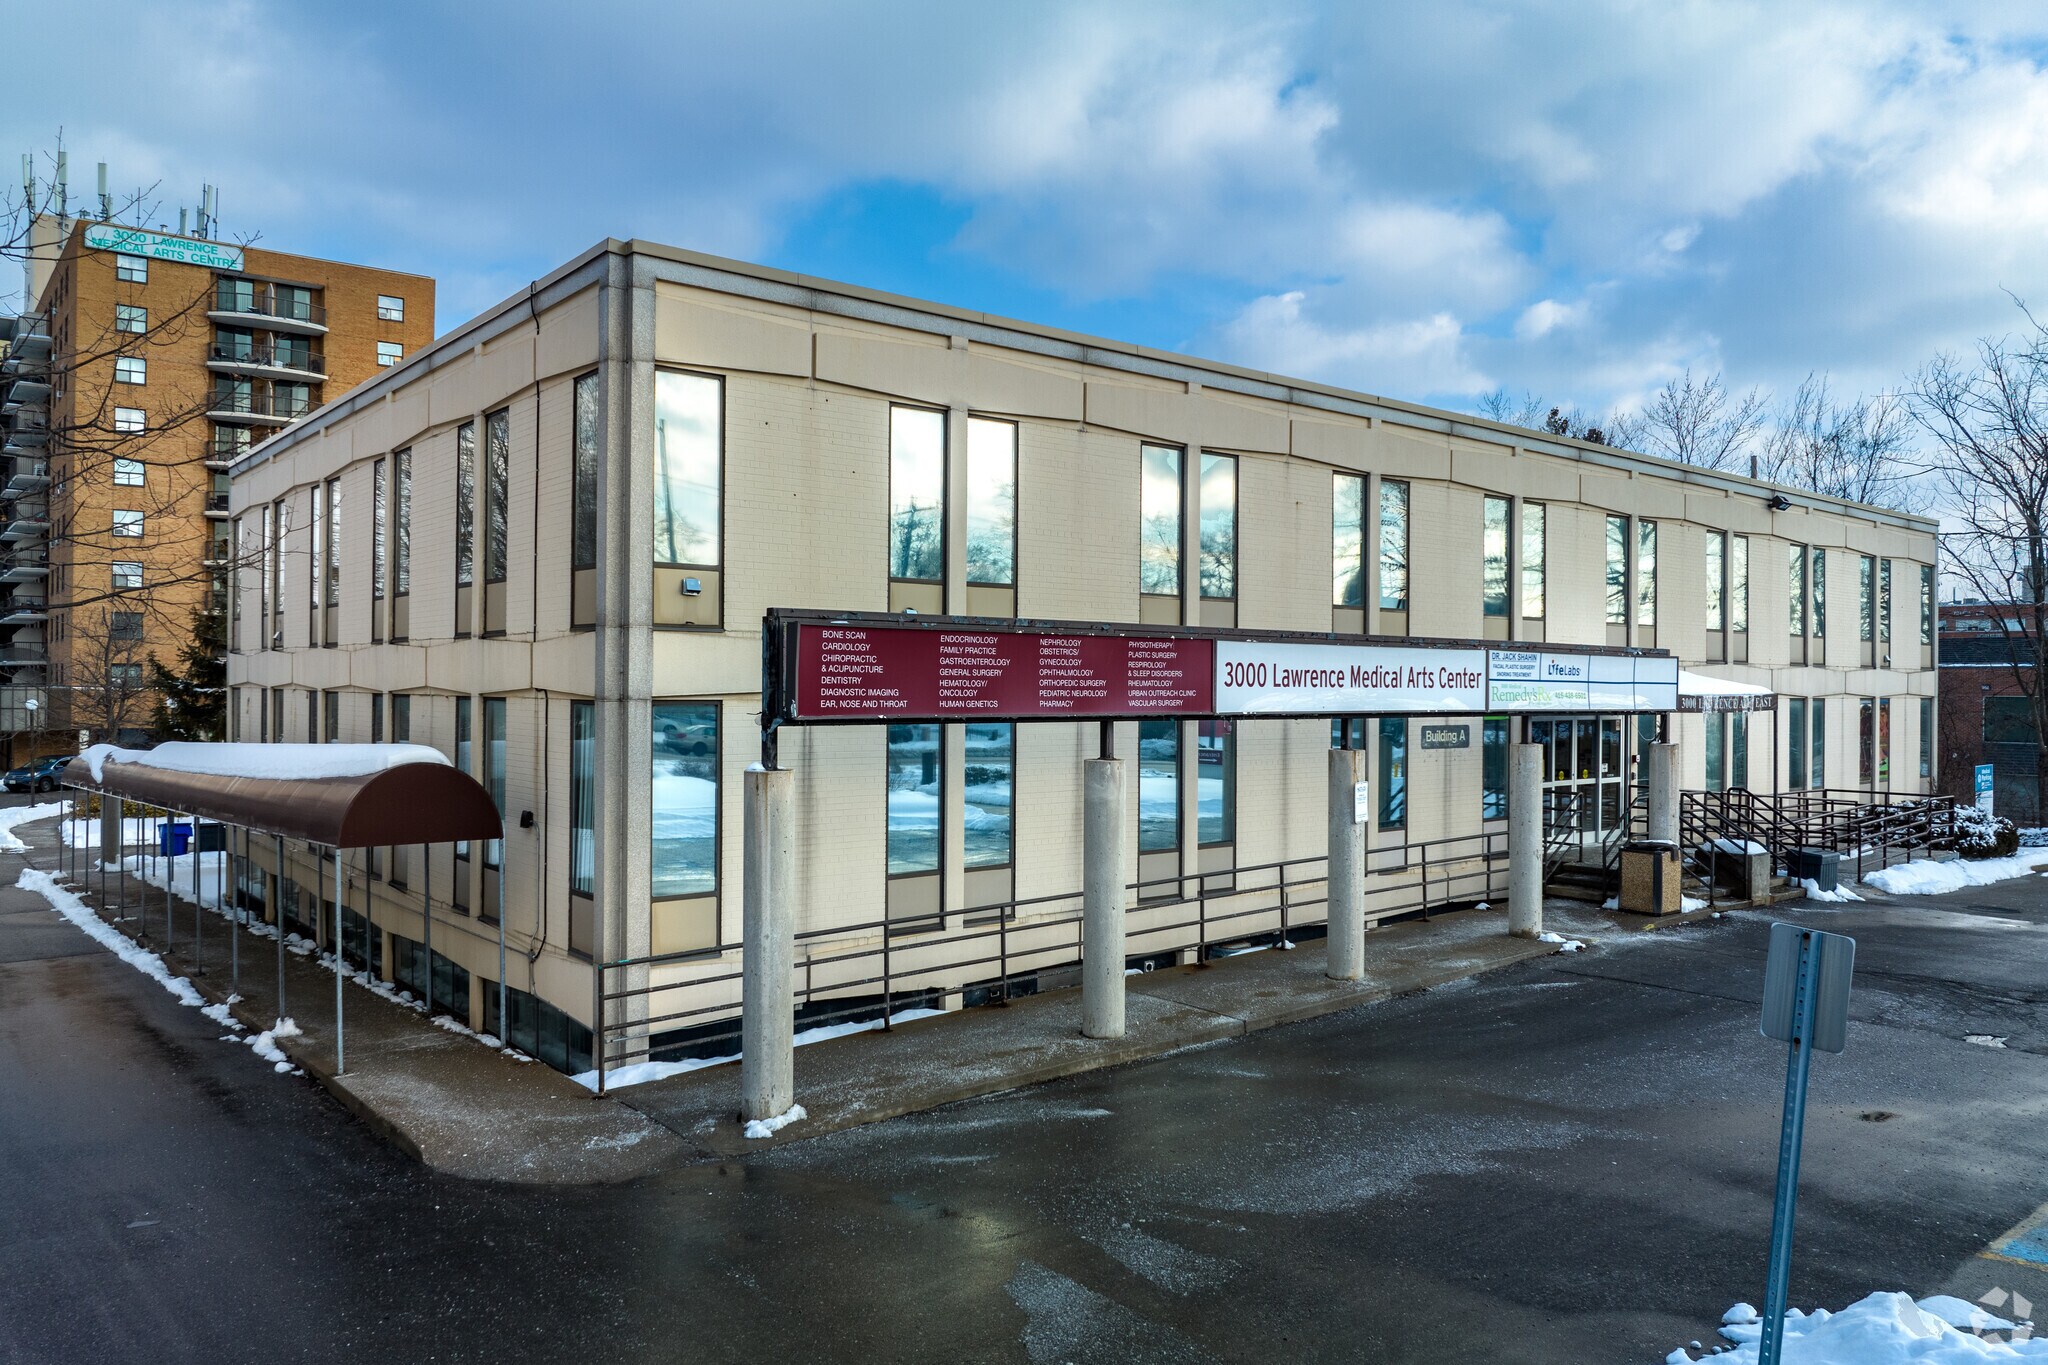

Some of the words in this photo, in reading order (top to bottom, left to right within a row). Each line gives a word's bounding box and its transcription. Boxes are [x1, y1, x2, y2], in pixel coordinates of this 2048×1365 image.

[113, 229, 147, 243] 3000
[152, 235, 219, 256] LAWRENCE
[91, 237, 147, 255] MEDICAL
[153, 247, 185, 261] ARTS
[190, 254, 238, 269] CENTRE
[822, 630, 844, 639] BONE
[845, 631, 866, 639] SCAN
[940, 635, 998, 644] ENDOCRINOLOGY
[1040, 638, 1082, 646] NEPHROLOGY
[822, 642, 871, 651] CARDIOLOGY
[1128, 641, 1173, 649] PHYSIOTHERAPY
[940, 646, 964, 654] FAMILY
[965, 647, 997, 655] PRACTICE
[1039, 647, 1080, 656] OBSTETRICS/
[1128, 651, 1151, 659] PLASTIC
[1152, 651, 1178, 659] SURGERY
[821, 654, 877, 663] CHIROPRACTIC
[1502, 652, 1516, 661] JACK
[1517, 653, 1537, 661] SHAHIN
[939, 657, 1011, 666] GASTROENTEROLOGY
[1039, 658, 1082, 666] GYNECOLOGY
[1128, 661, 1167, 669] RESPIROLOGY
[821, 665, 827, 673] &
[828, 665, 884, 673] ACUPUNCTURE
[939, 668, 971, 676] GENERAL
[972, 669, 1003, 677] SURGERY
[1039, 668, 1094, 676] OPHTHALMOLOGY
[1548, 660, 1580, 676] LifeLabs
[1151, 670, 1183, 678] DISORDERS
[1224, 661, 1267, 688] 3000
[1273, 663, 1345, 689] Lawrence
[1350, 664, 1402, 689] Medical
[1407, 666, 1435, 689] Arts
[1438, 666, 1482, 689] Center
[821, 676, 862, 685] DENTISTRY
[939, 679, 988, 687] HEMATOLOGY/
[1039, 679, 1078, 687] ORTHOPEDIC
[821, 688, 867, 696] DIAGNOSTIC
[868, 689, 899, 697] IMAGING
[939, 689, 978, 697] ONCOLOGY
[1039, 689, 1071, 697] PEDIATRIC
[820, 700, 838, 708] EAR,
[840, 700, 860, 708] NOSE
[862, 700, 878, 708] AND
[880, 700, 908, 708] THROAT
[939, 700, 965, 708] HUMAN
[966, 700, 999, 708] GENETICS
[1039, 700, 1074, 708] PHARMACY
[1128, 699, 1157, 707] VASCULAR
[1158, 699, 1184, 707] SURGERY
[1682, 697, 1696, 709] 3000
[1755, 696, 1772, 708] EAST
[1426, 730, 1457, 743] Building
[1460, 730, 1466, 740] A
